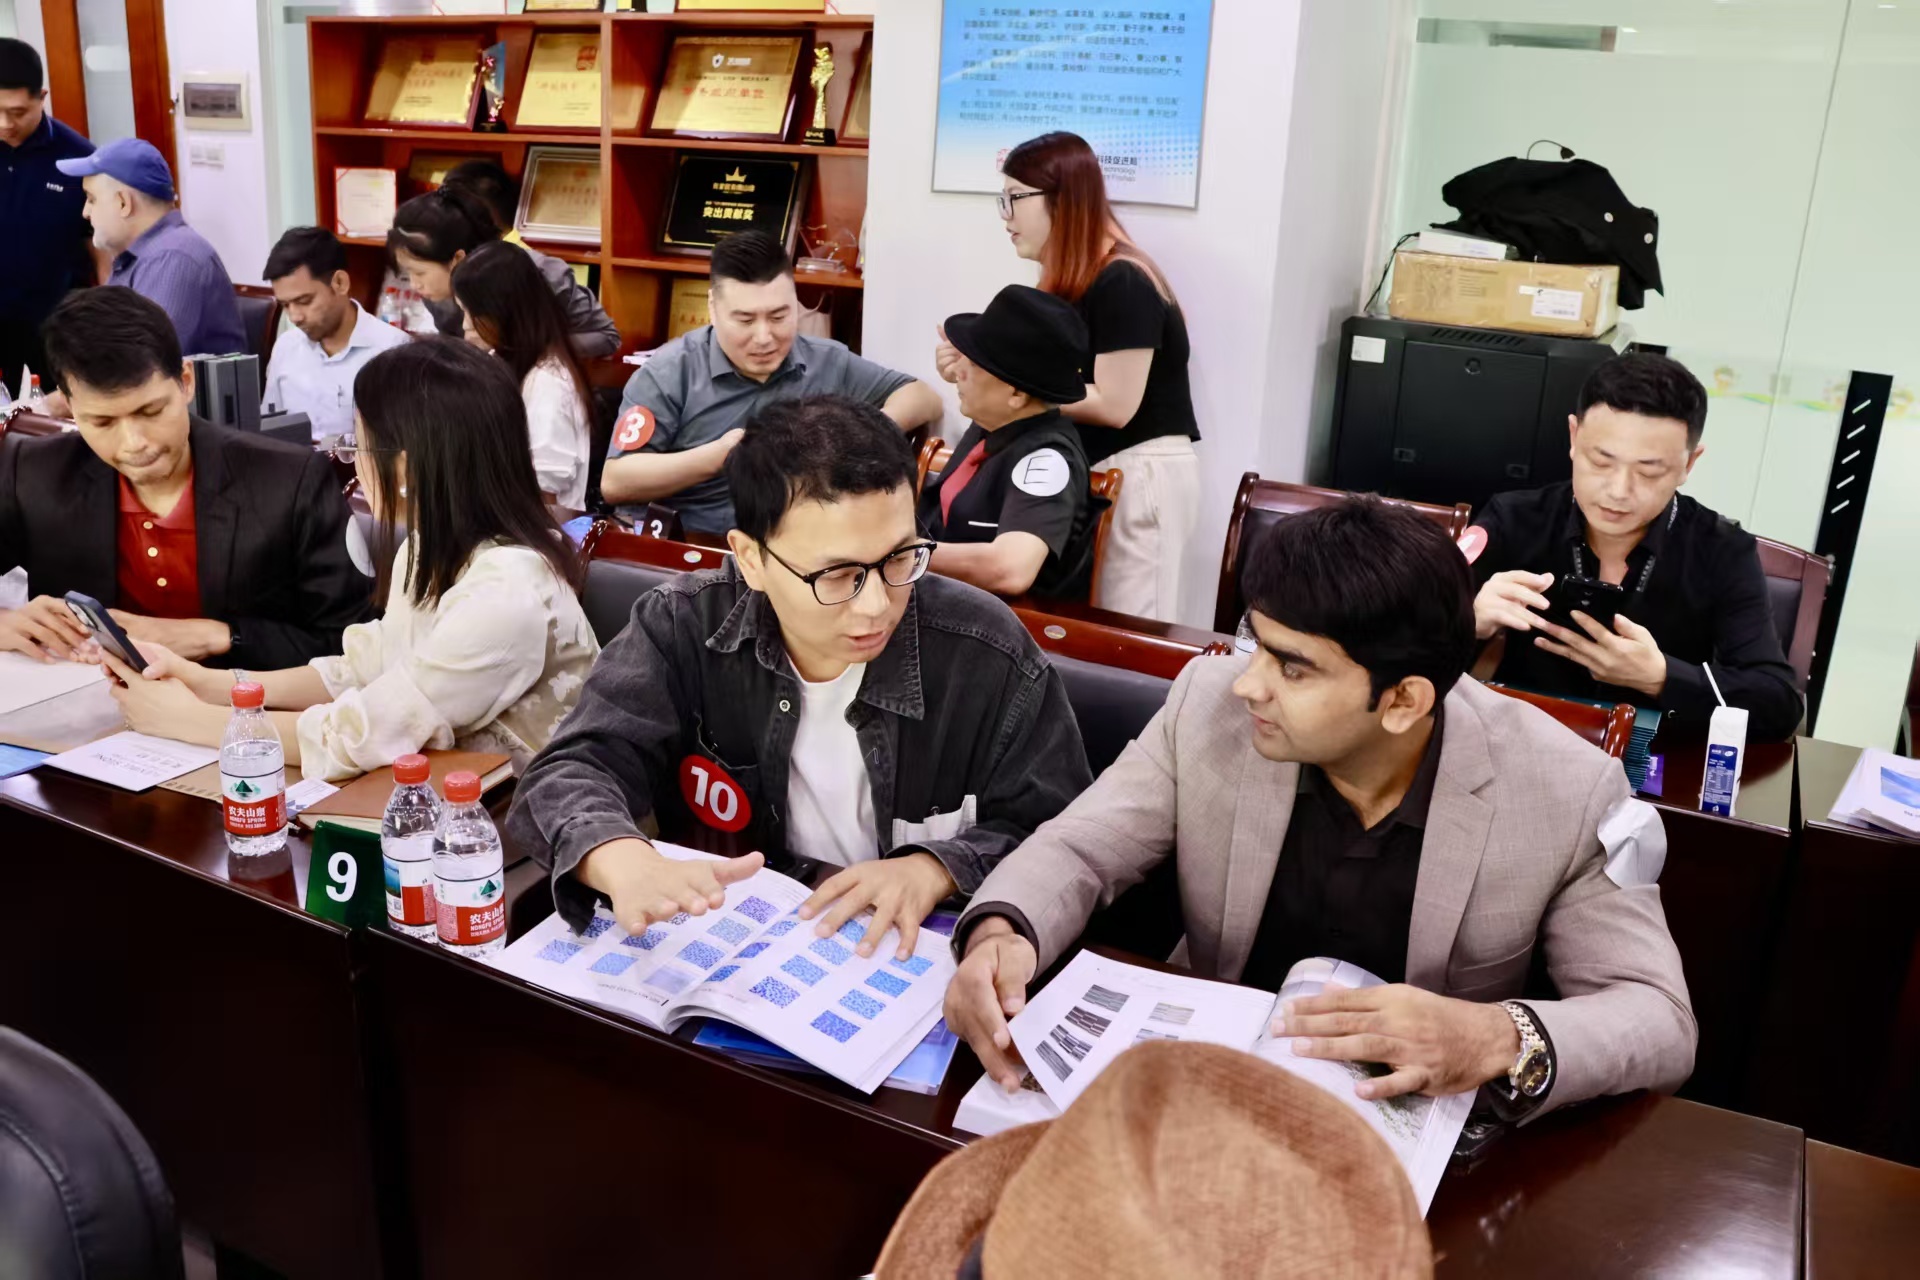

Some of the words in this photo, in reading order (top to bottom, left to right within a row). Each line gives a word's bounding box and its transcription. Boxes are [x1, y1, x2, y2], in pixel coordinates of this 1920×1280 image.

[702, 206, 754, 221] 突出贡献奖
[619, 412, 646, 444] 3
[690, 765, 738, 822] 10
[228, 805, 267, 817] 农夫山泉
[325, 851, 358, 903] 9
